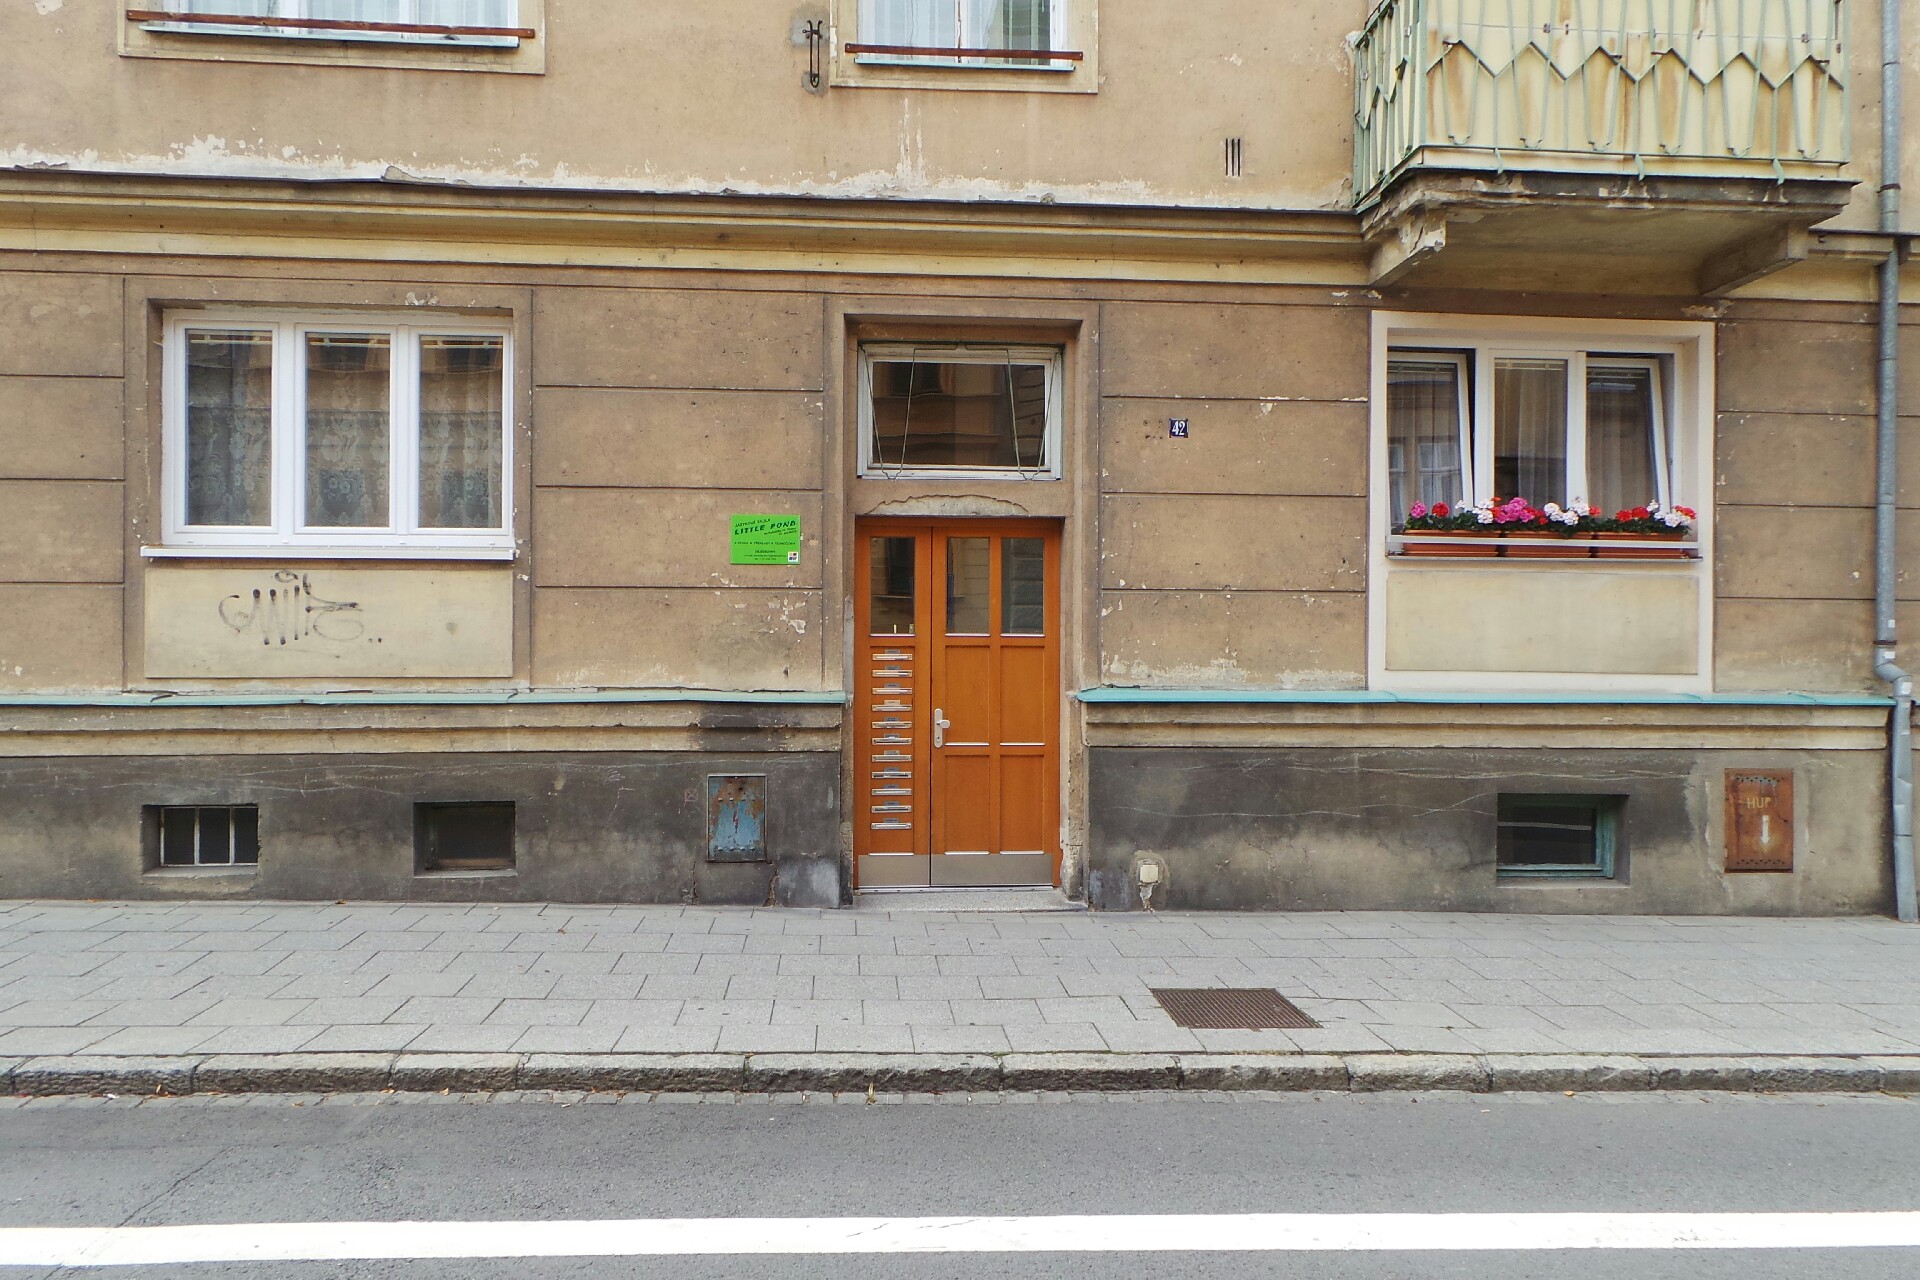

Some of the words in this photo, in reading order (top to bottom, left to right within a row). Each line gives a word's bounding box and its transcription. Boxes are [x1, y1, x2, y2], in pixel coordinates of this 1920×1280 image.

[1171, 420, 1186, 436] 42
[734, 524, 766, 535] LITTLE
[770, 520, 796, 530] POND
